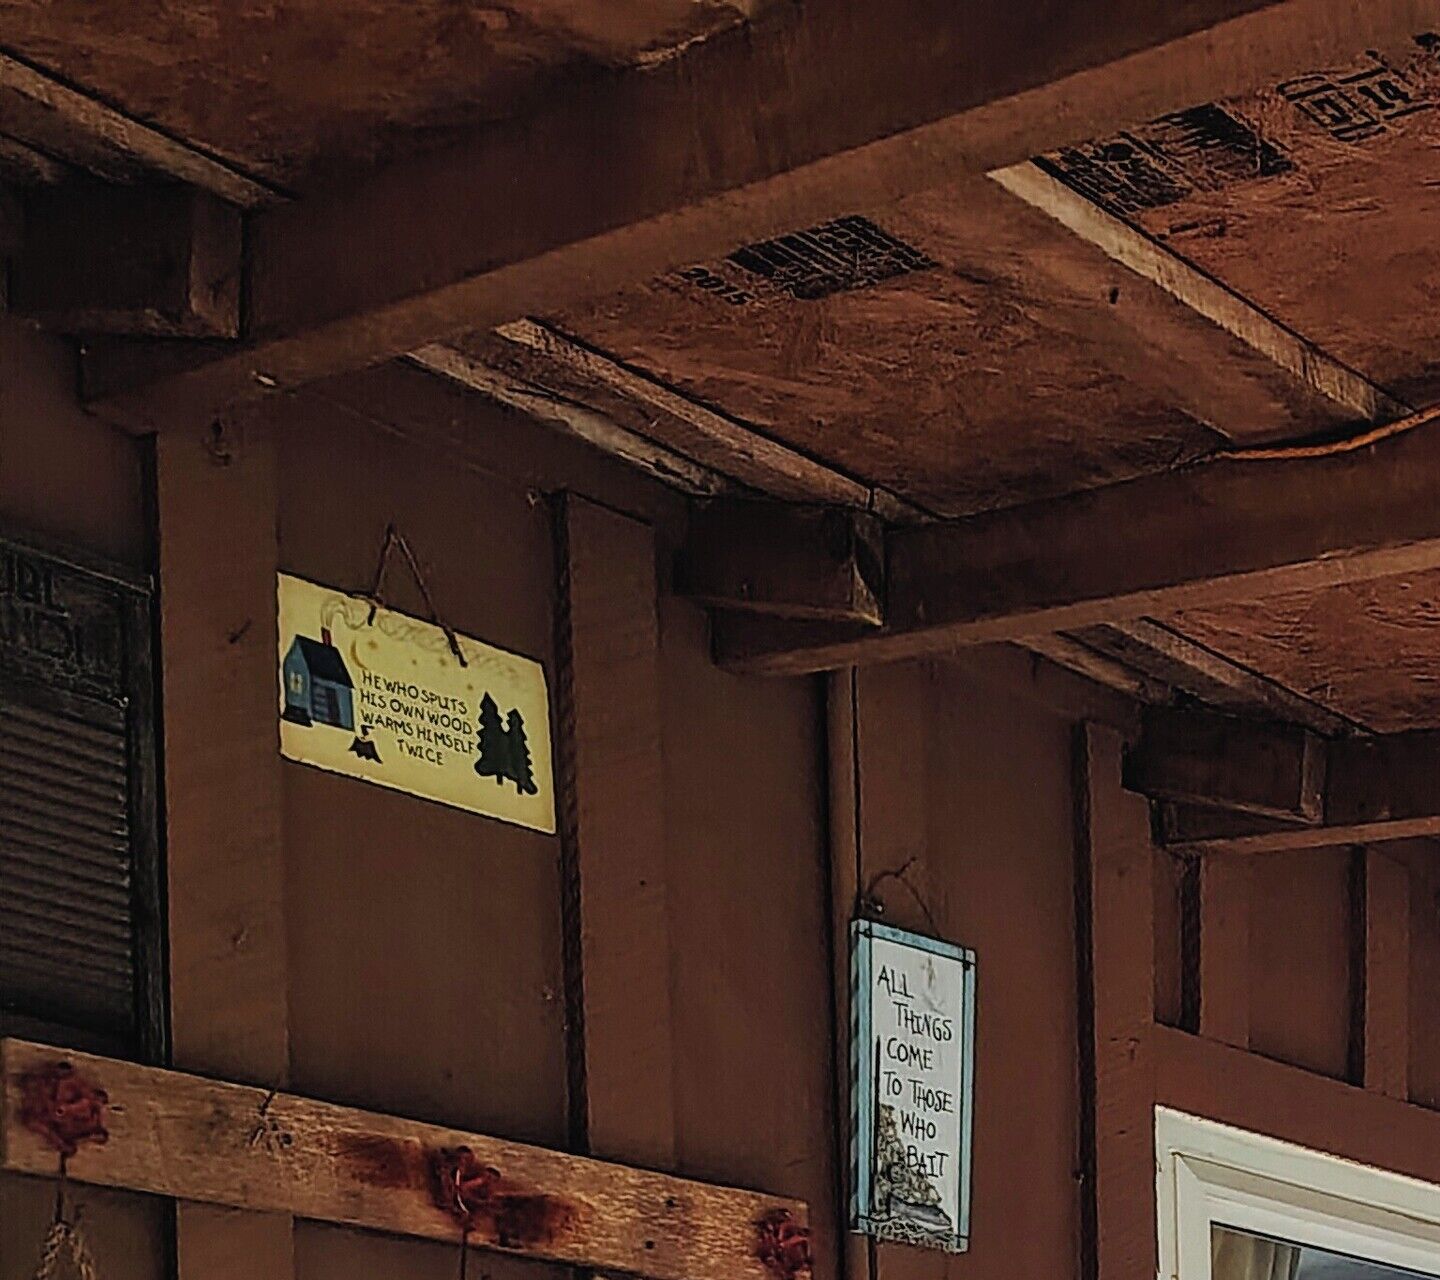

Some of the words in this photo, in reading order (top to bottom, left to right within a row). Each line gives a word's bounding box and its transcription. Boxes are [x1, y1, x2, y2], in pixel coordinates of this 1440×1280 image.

[362, 670, 381, 690] HE
[384, 678, 418, 699] WHO
[420, 690, 467, 715] SPLITS
[360, 688, 387, 709] HIS
[390, 699, 424, 720] OWN
[427, 710, 472, 735] WOOD
[361, 709, 413, 736] WARMS
[416, 724, 475, 754] HIMSELF
[397, 738, 443, 765] TWICE
[877, 965, 914, 999] ALL
[893, 1001, 952, 1041] THINGS
[887, 1038, 933, 1071] COME
[883, 1071, 902, 1095] TO
[908, 1079, 953, 1113] THOSE
[900, 1110, 936, 1141] WHO
[907, 1145, 949, 1179] BAIT
